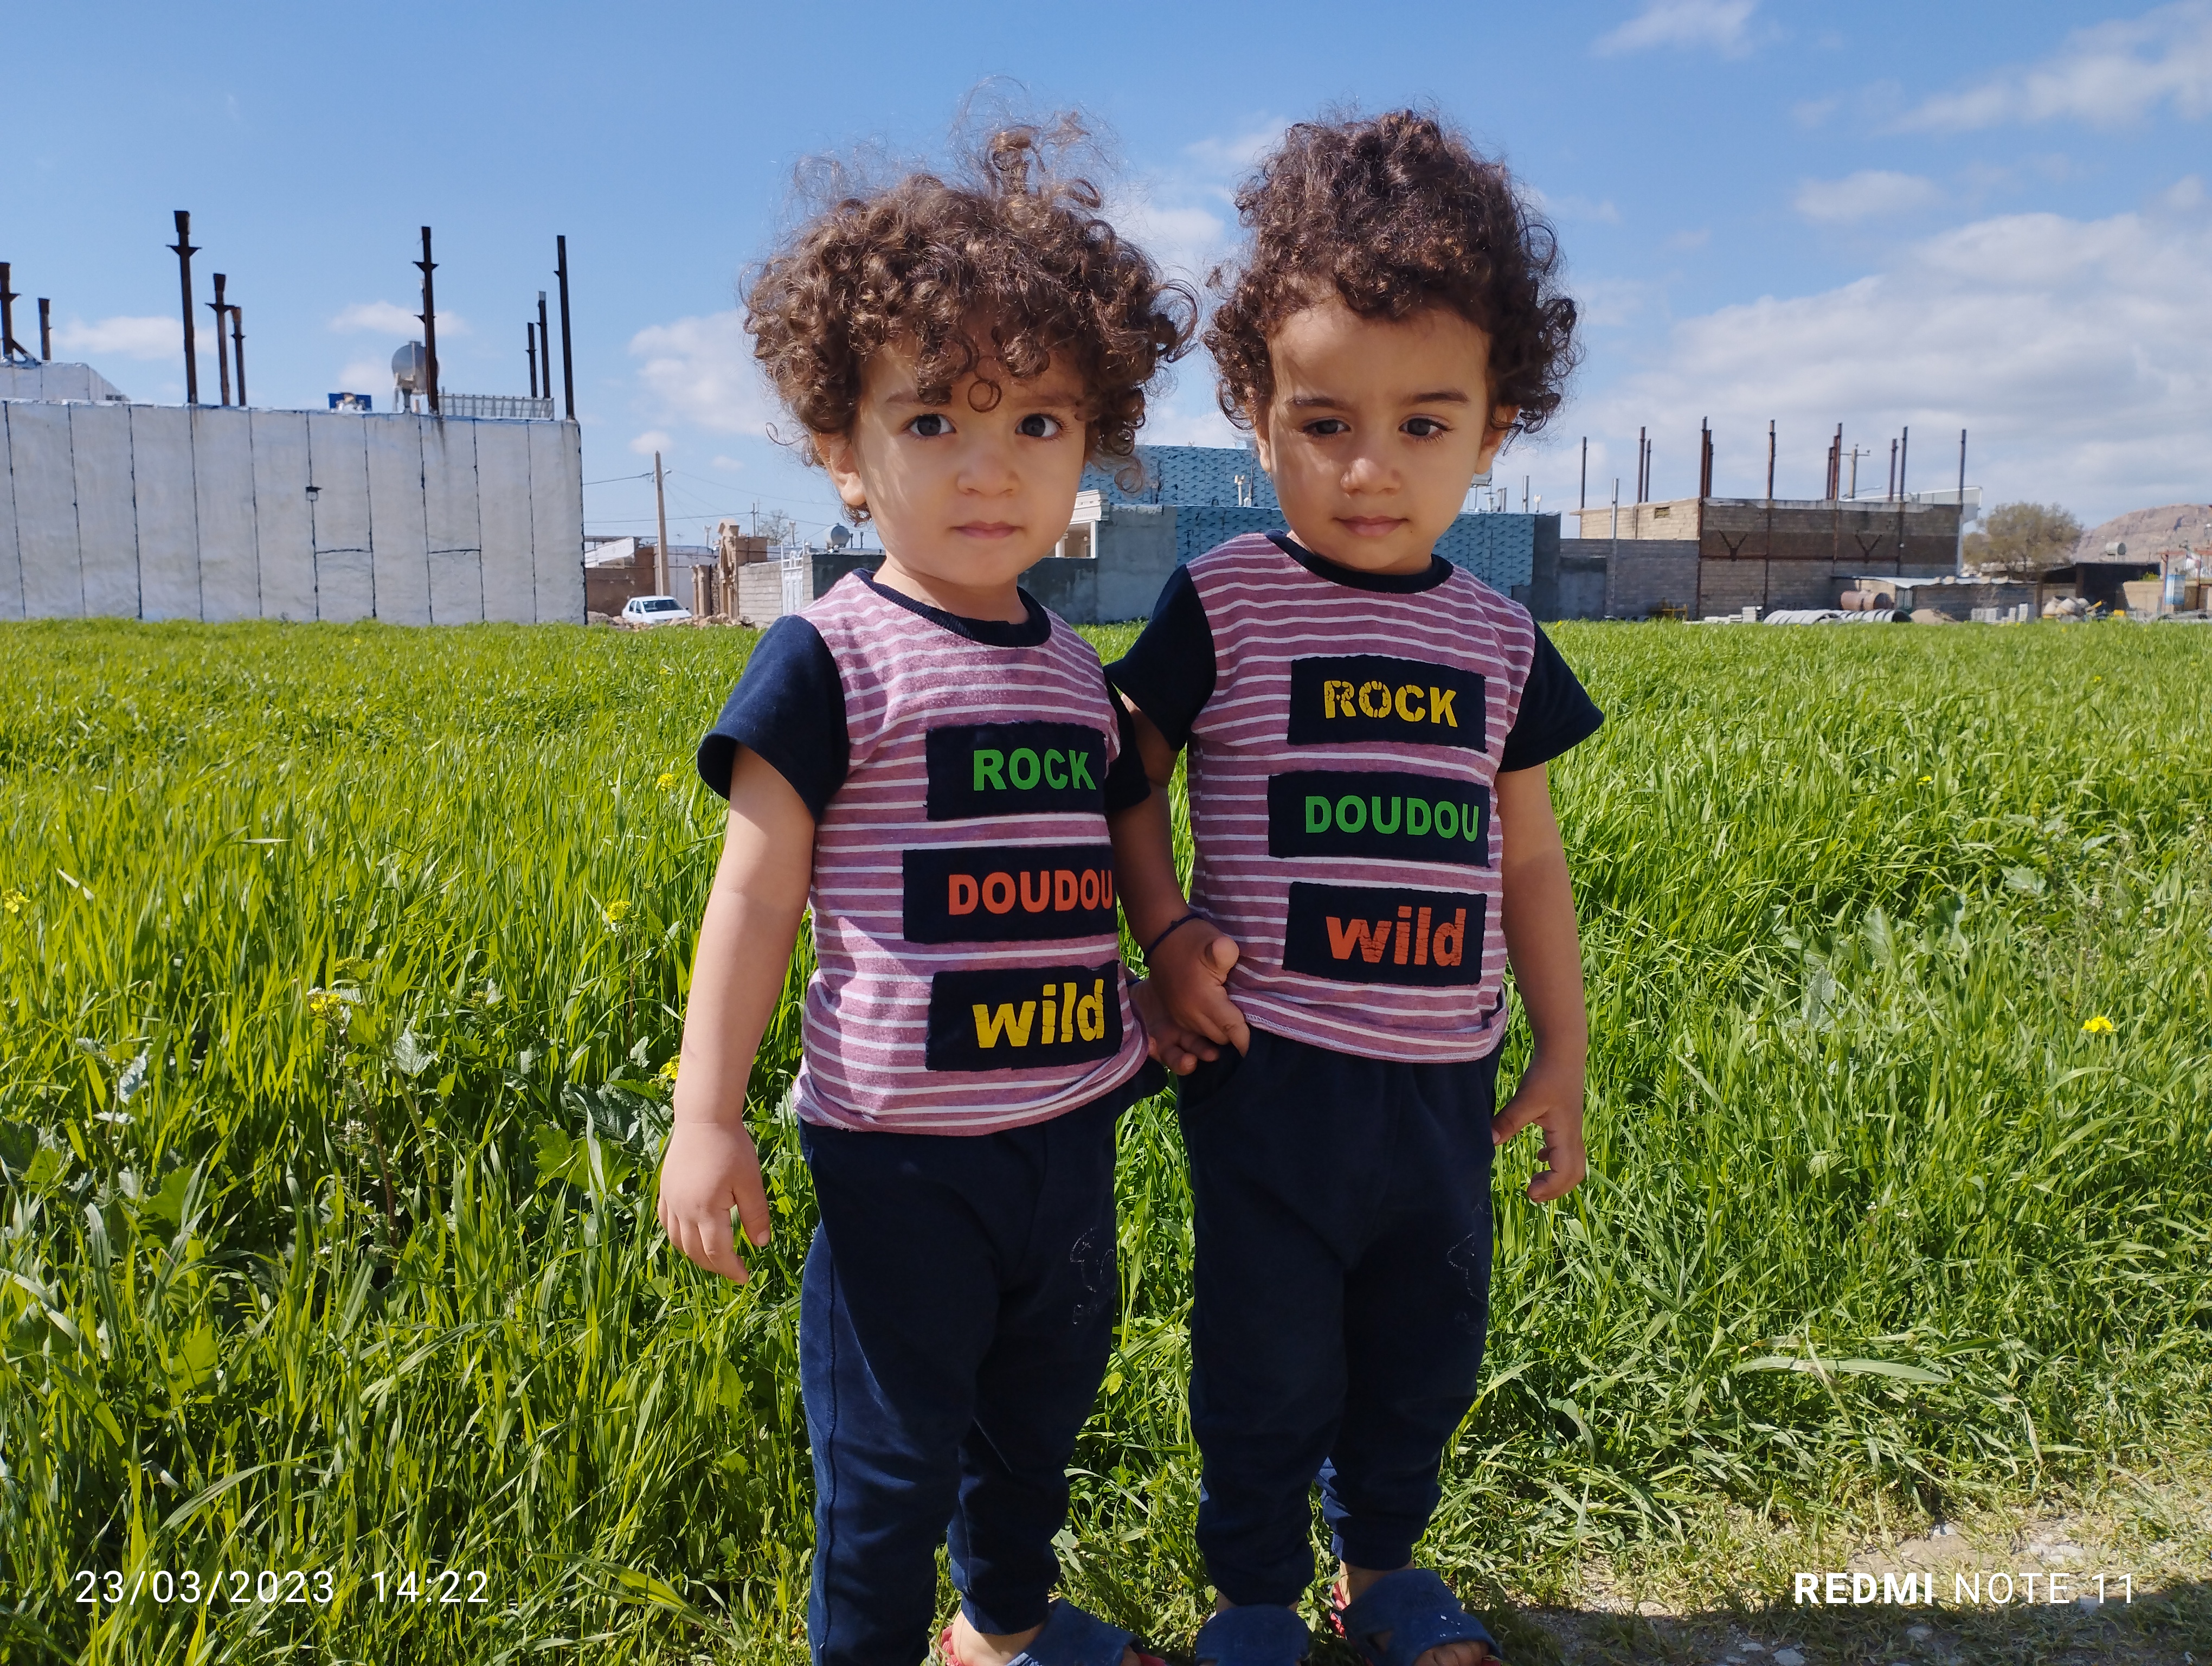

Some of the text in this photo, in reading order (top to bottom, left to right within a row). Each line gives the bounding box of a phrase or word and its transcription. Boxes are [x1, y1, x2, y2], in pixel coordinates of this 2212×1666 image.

[1323, 680, 1458, 728] ROCK
[974, 748, 1096, 791] ROCK
[1306, 795, 1479, 842] DOUDOU
[948, 869, 1113, 915] DOUDOU
[1326, 906, 1467, 966] wild
[972, 978, 1104, 1048] wild
